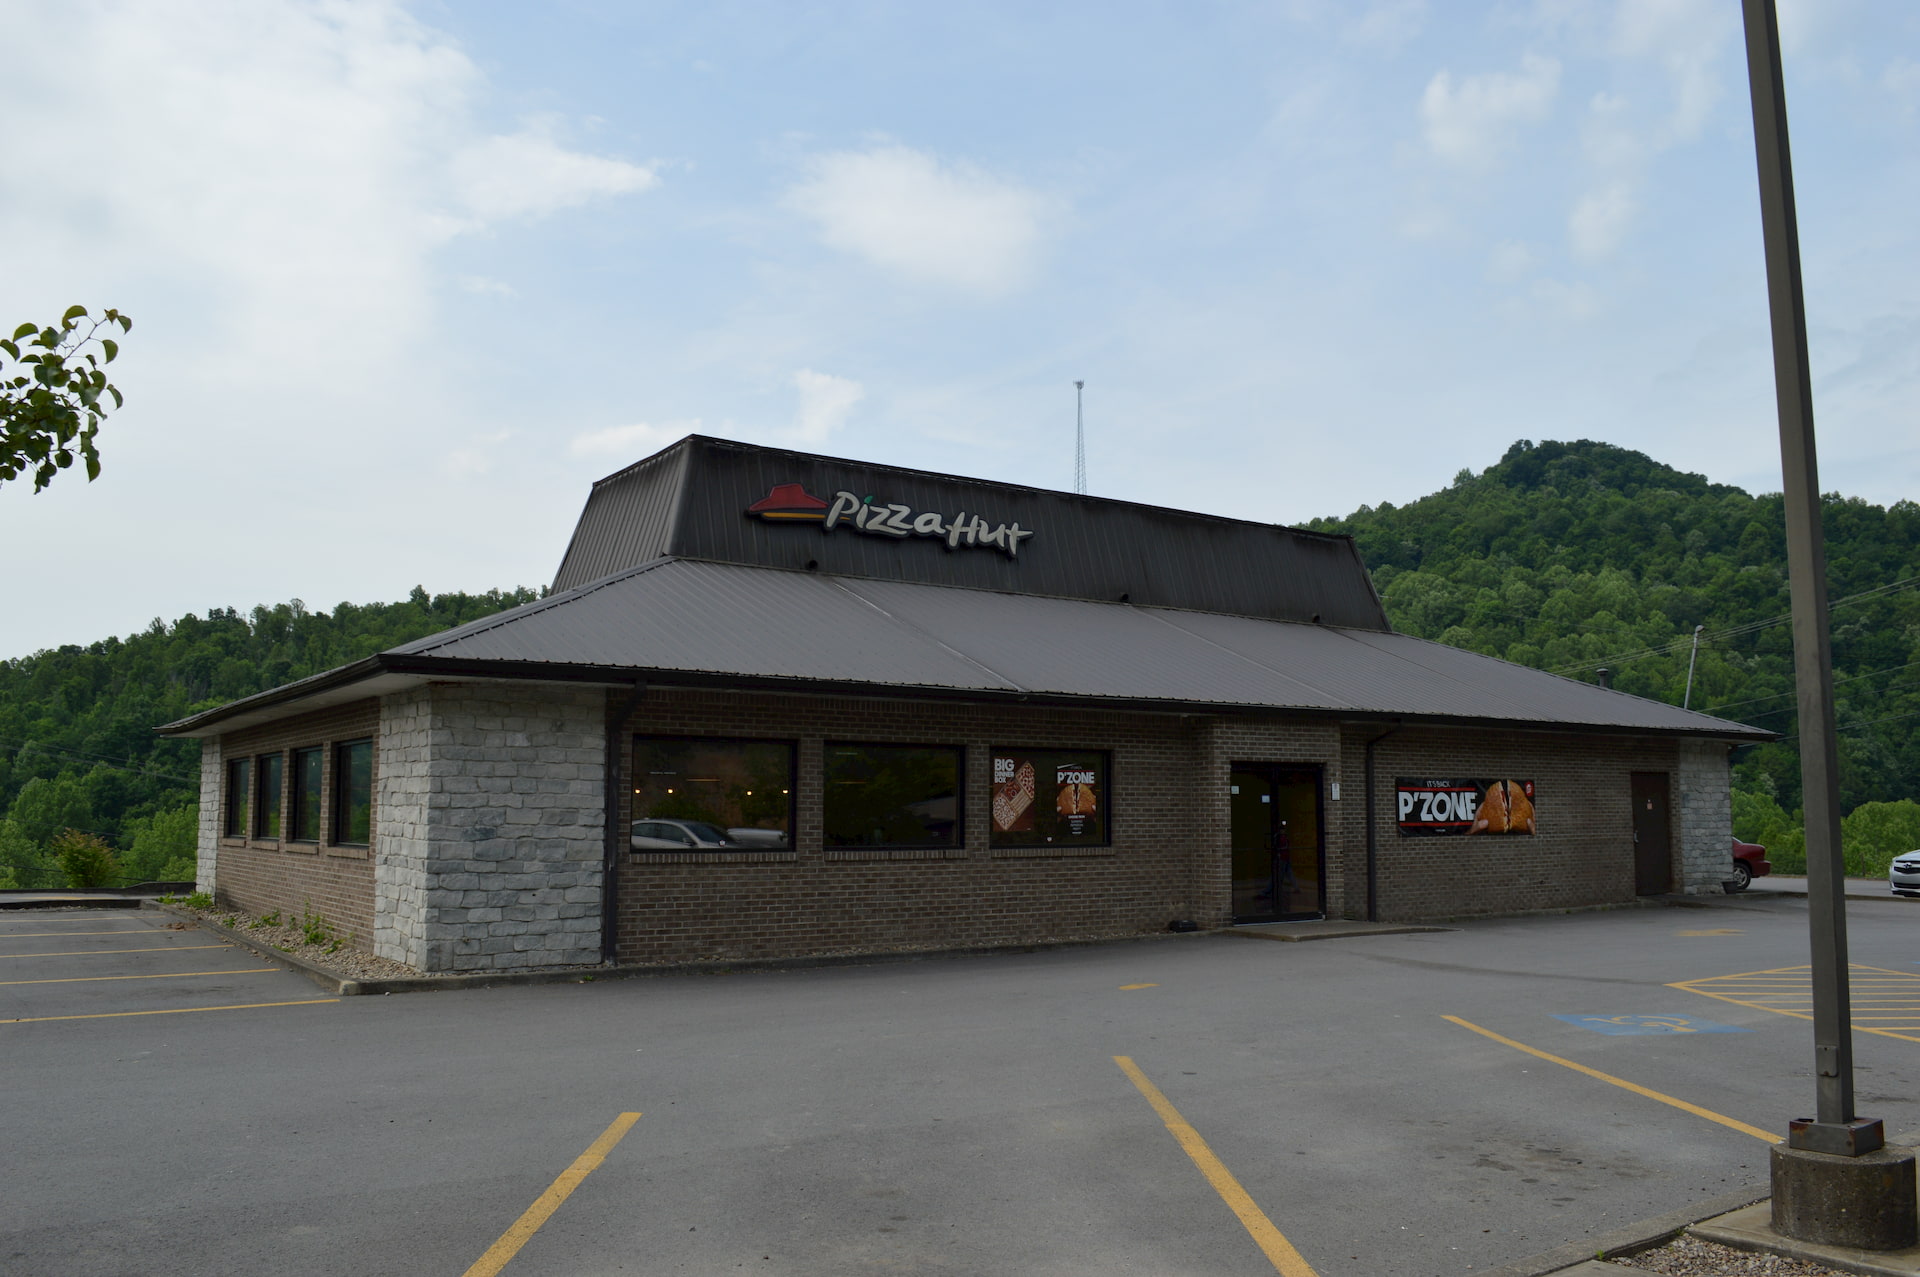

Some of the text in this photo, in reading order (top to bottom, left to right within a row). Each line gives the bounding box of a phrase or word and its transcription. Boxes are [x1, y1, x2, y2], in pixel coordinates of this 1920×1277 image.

[826, 491, 1033, 556] Pizza Hut
[994, 759, 1015, 771] BIG
[1057, 772, 1095, 784] P'ZONE
[1398, 791, 1477, 822] P'ZONE
